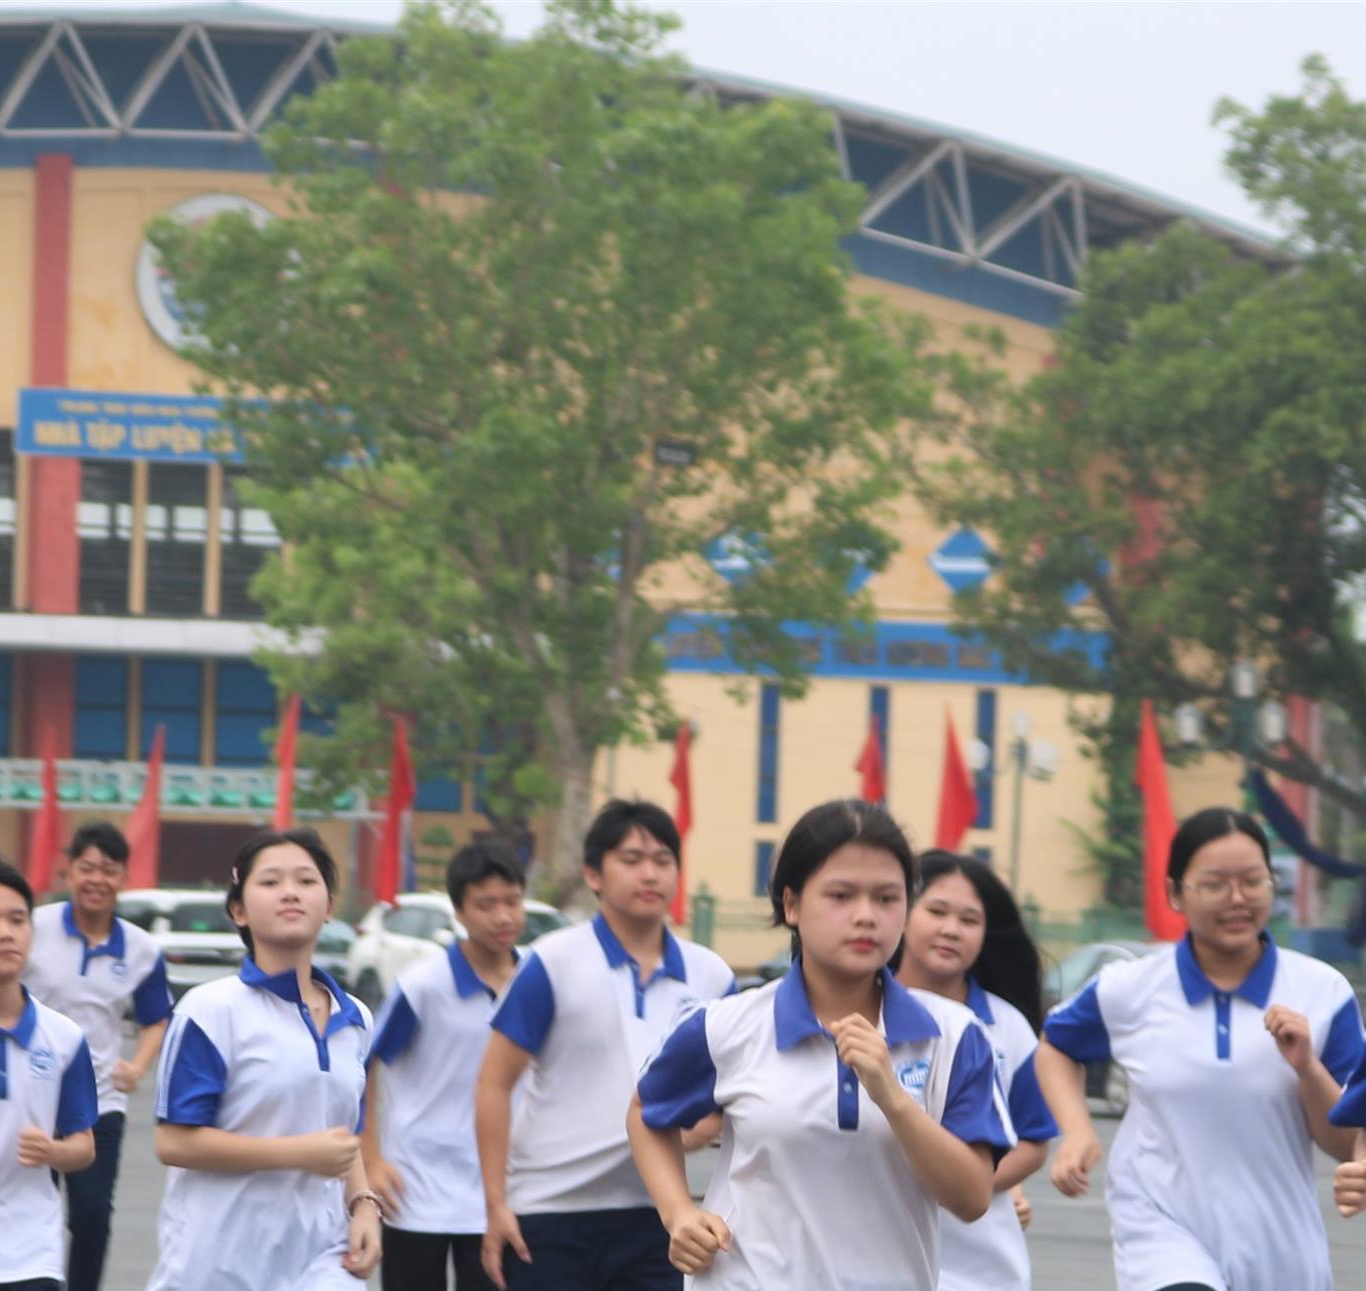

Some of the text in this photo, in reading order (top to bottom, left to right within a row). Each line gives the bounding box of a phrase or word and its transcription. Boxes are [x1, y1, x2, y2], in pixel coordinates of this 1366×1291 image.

[35, 416, 81, 446] NHÀ
[86, 418, 126, 451] TẬP
[131, 420, 202, 455] LUYỆN
